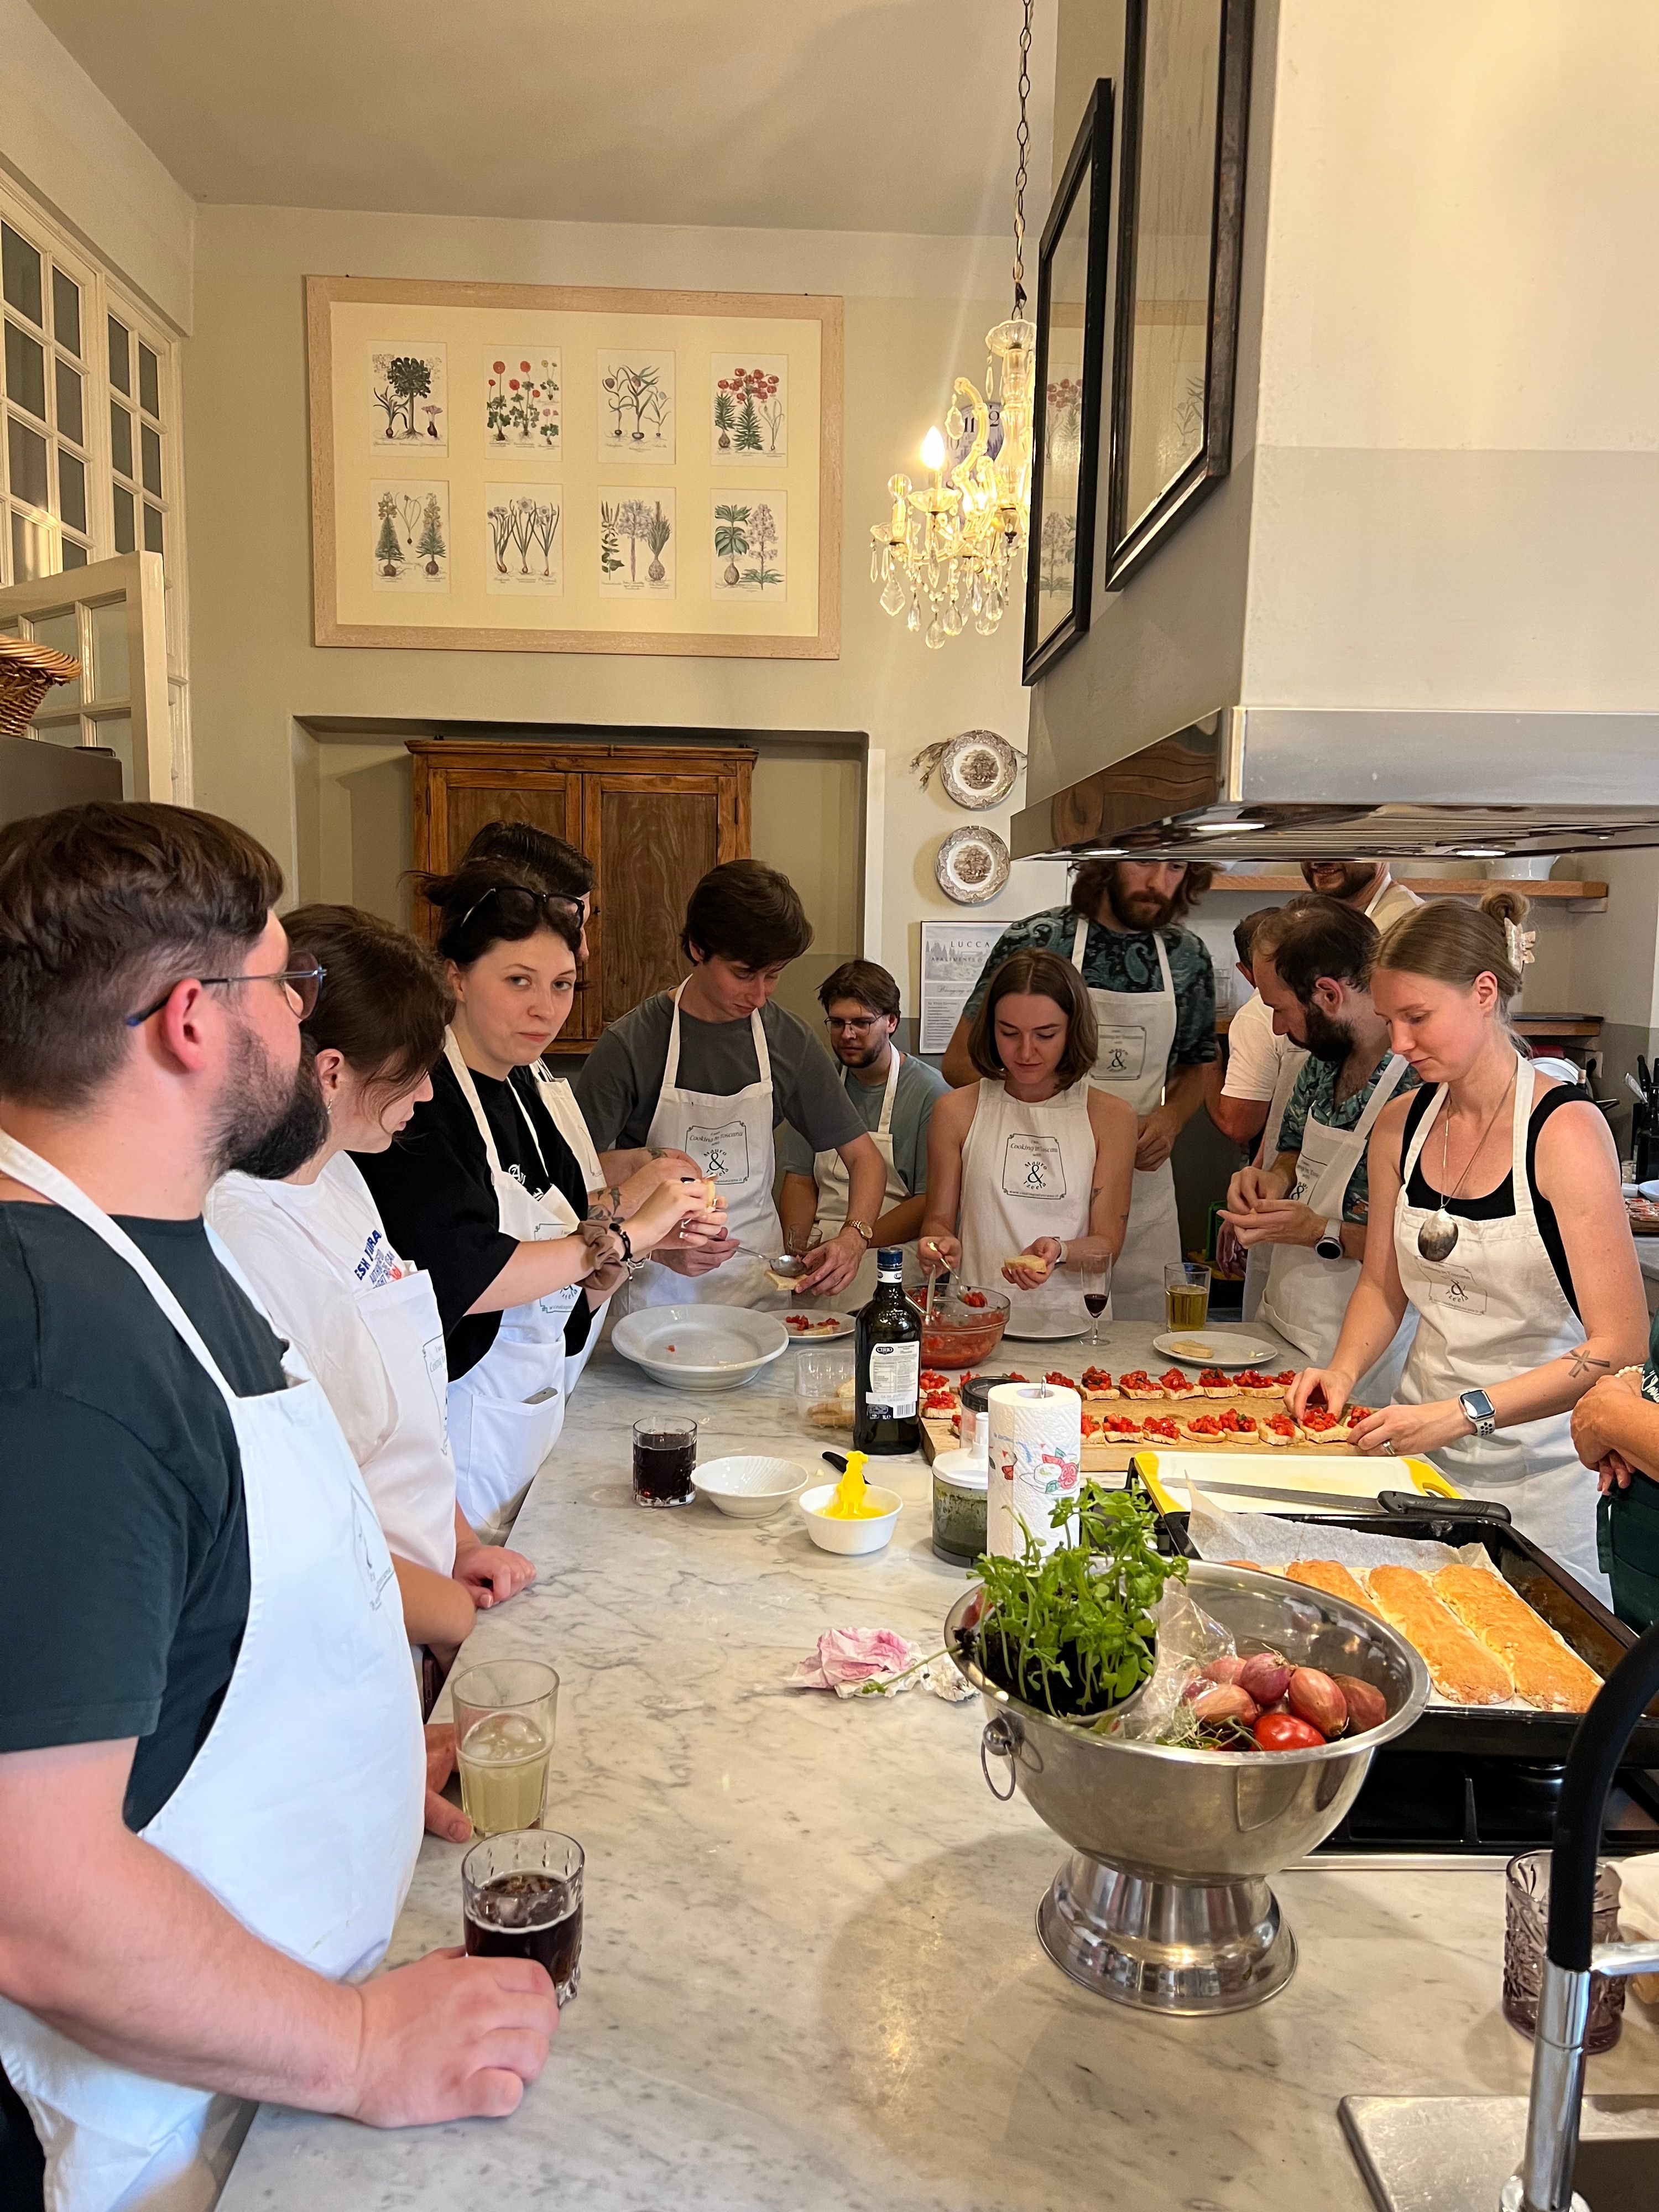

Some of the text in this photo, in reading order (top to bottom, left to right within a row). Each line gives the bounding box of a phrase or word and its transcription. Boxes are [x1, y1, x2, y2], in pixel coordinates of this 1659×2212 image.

[1112, 1051, 1125, 1067] &
[1010, 1142, 1034, 1152] Cooking
[709, 1152, 725, 1171] &
[1024, 1161, 1047, 1170] Mauro
[1027, 1164, 1044, 1183] &
